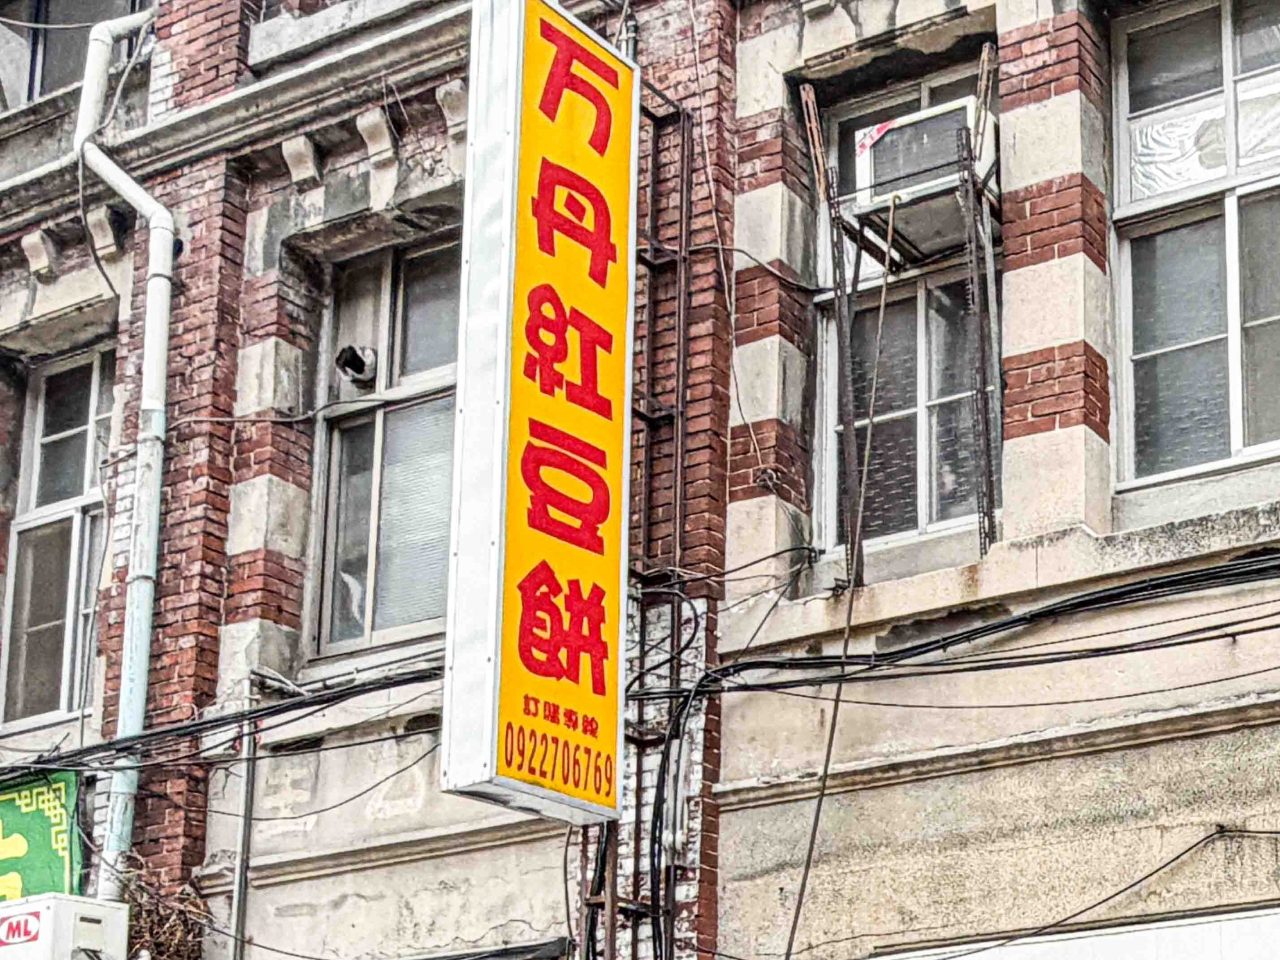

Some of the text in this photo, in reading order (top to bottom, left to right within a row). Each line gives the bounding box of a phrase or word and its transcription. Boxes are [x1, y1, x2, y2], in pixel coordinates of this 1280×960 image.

[516, 17, 620, 697] 万丹紅豆餅
[505, 721, 613, 798] 0922706769
[6, 919, 32, 940] ML
